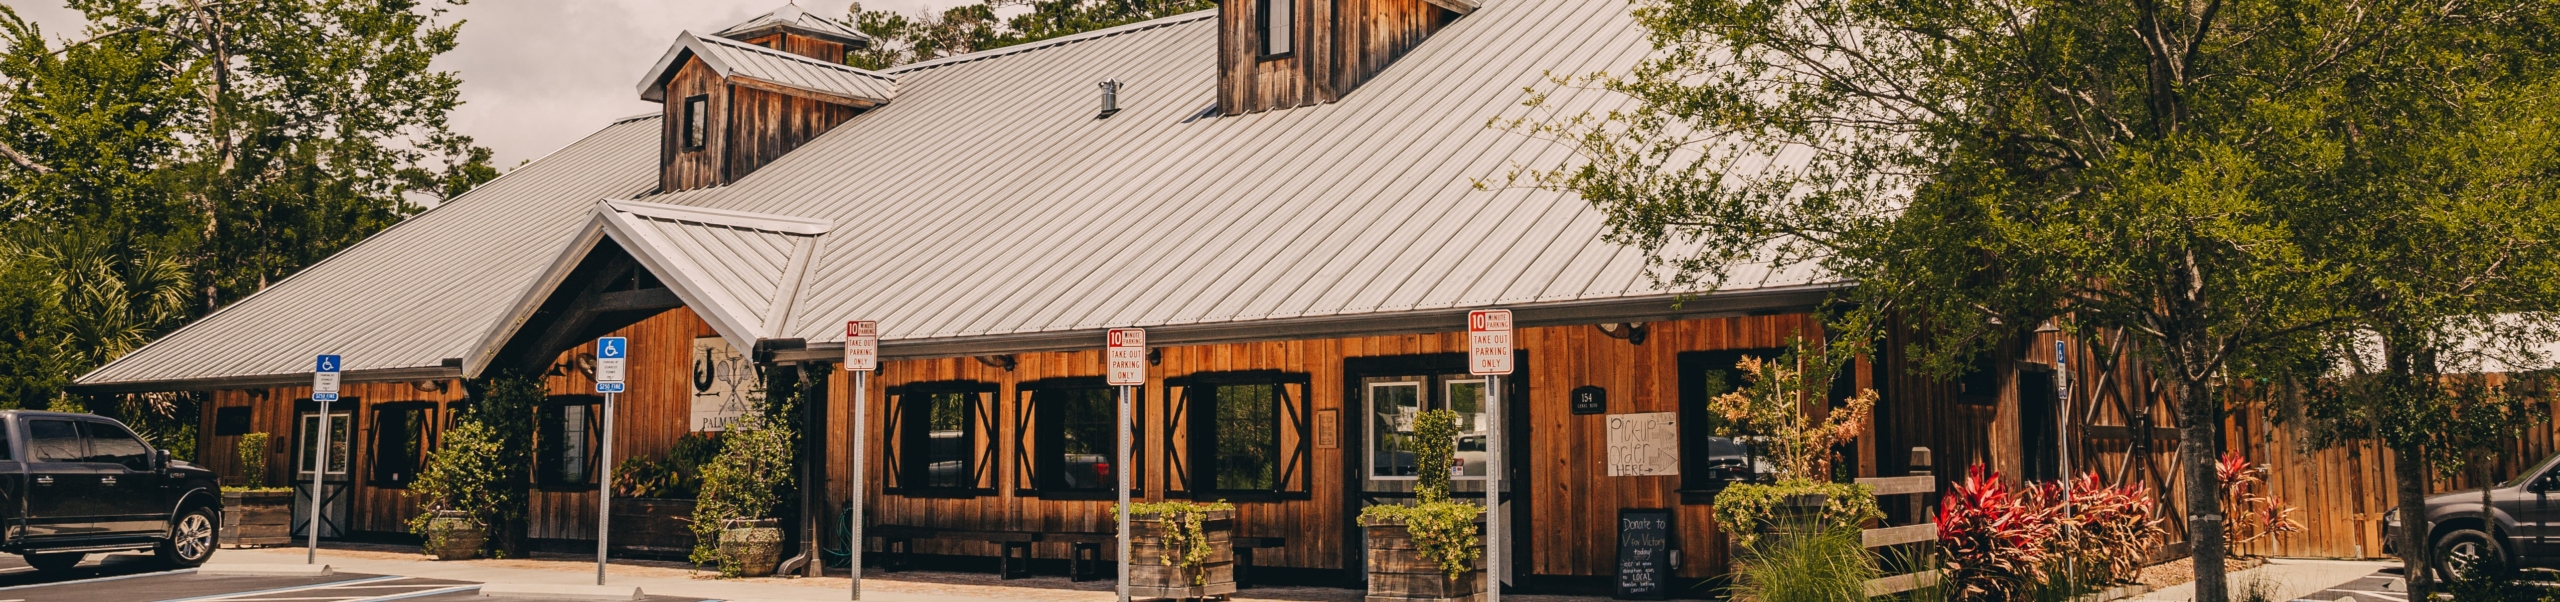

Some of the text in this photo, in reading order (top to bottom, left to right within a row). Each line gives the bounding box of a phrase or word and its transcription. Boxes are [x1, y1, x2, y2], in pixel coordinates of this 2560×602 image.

[1472, 314, 1484, 329] 10
[849, 323, 858, 335] 10
[1110, 332, 1122, 345] 10
[1474, 334, 1508, 344] TAKE OUT
[1112, 350, 1126, 358] TAKE
[1476, 346, 1506, 356] PARKING
[1482, 359, 1500, 368] ONLY
[1118, 372, 1134, 380] ONLY
[1582, 393, 1592, 402] 154
[703, 417, 726, 428] PALM
[1616, 464, 1644, 476] HERE
[1623, 518, 1666, 531] Donate to
[1642, 533, 1665, 551] Victory
[1633, 572, 1652, 581] LOCAL
